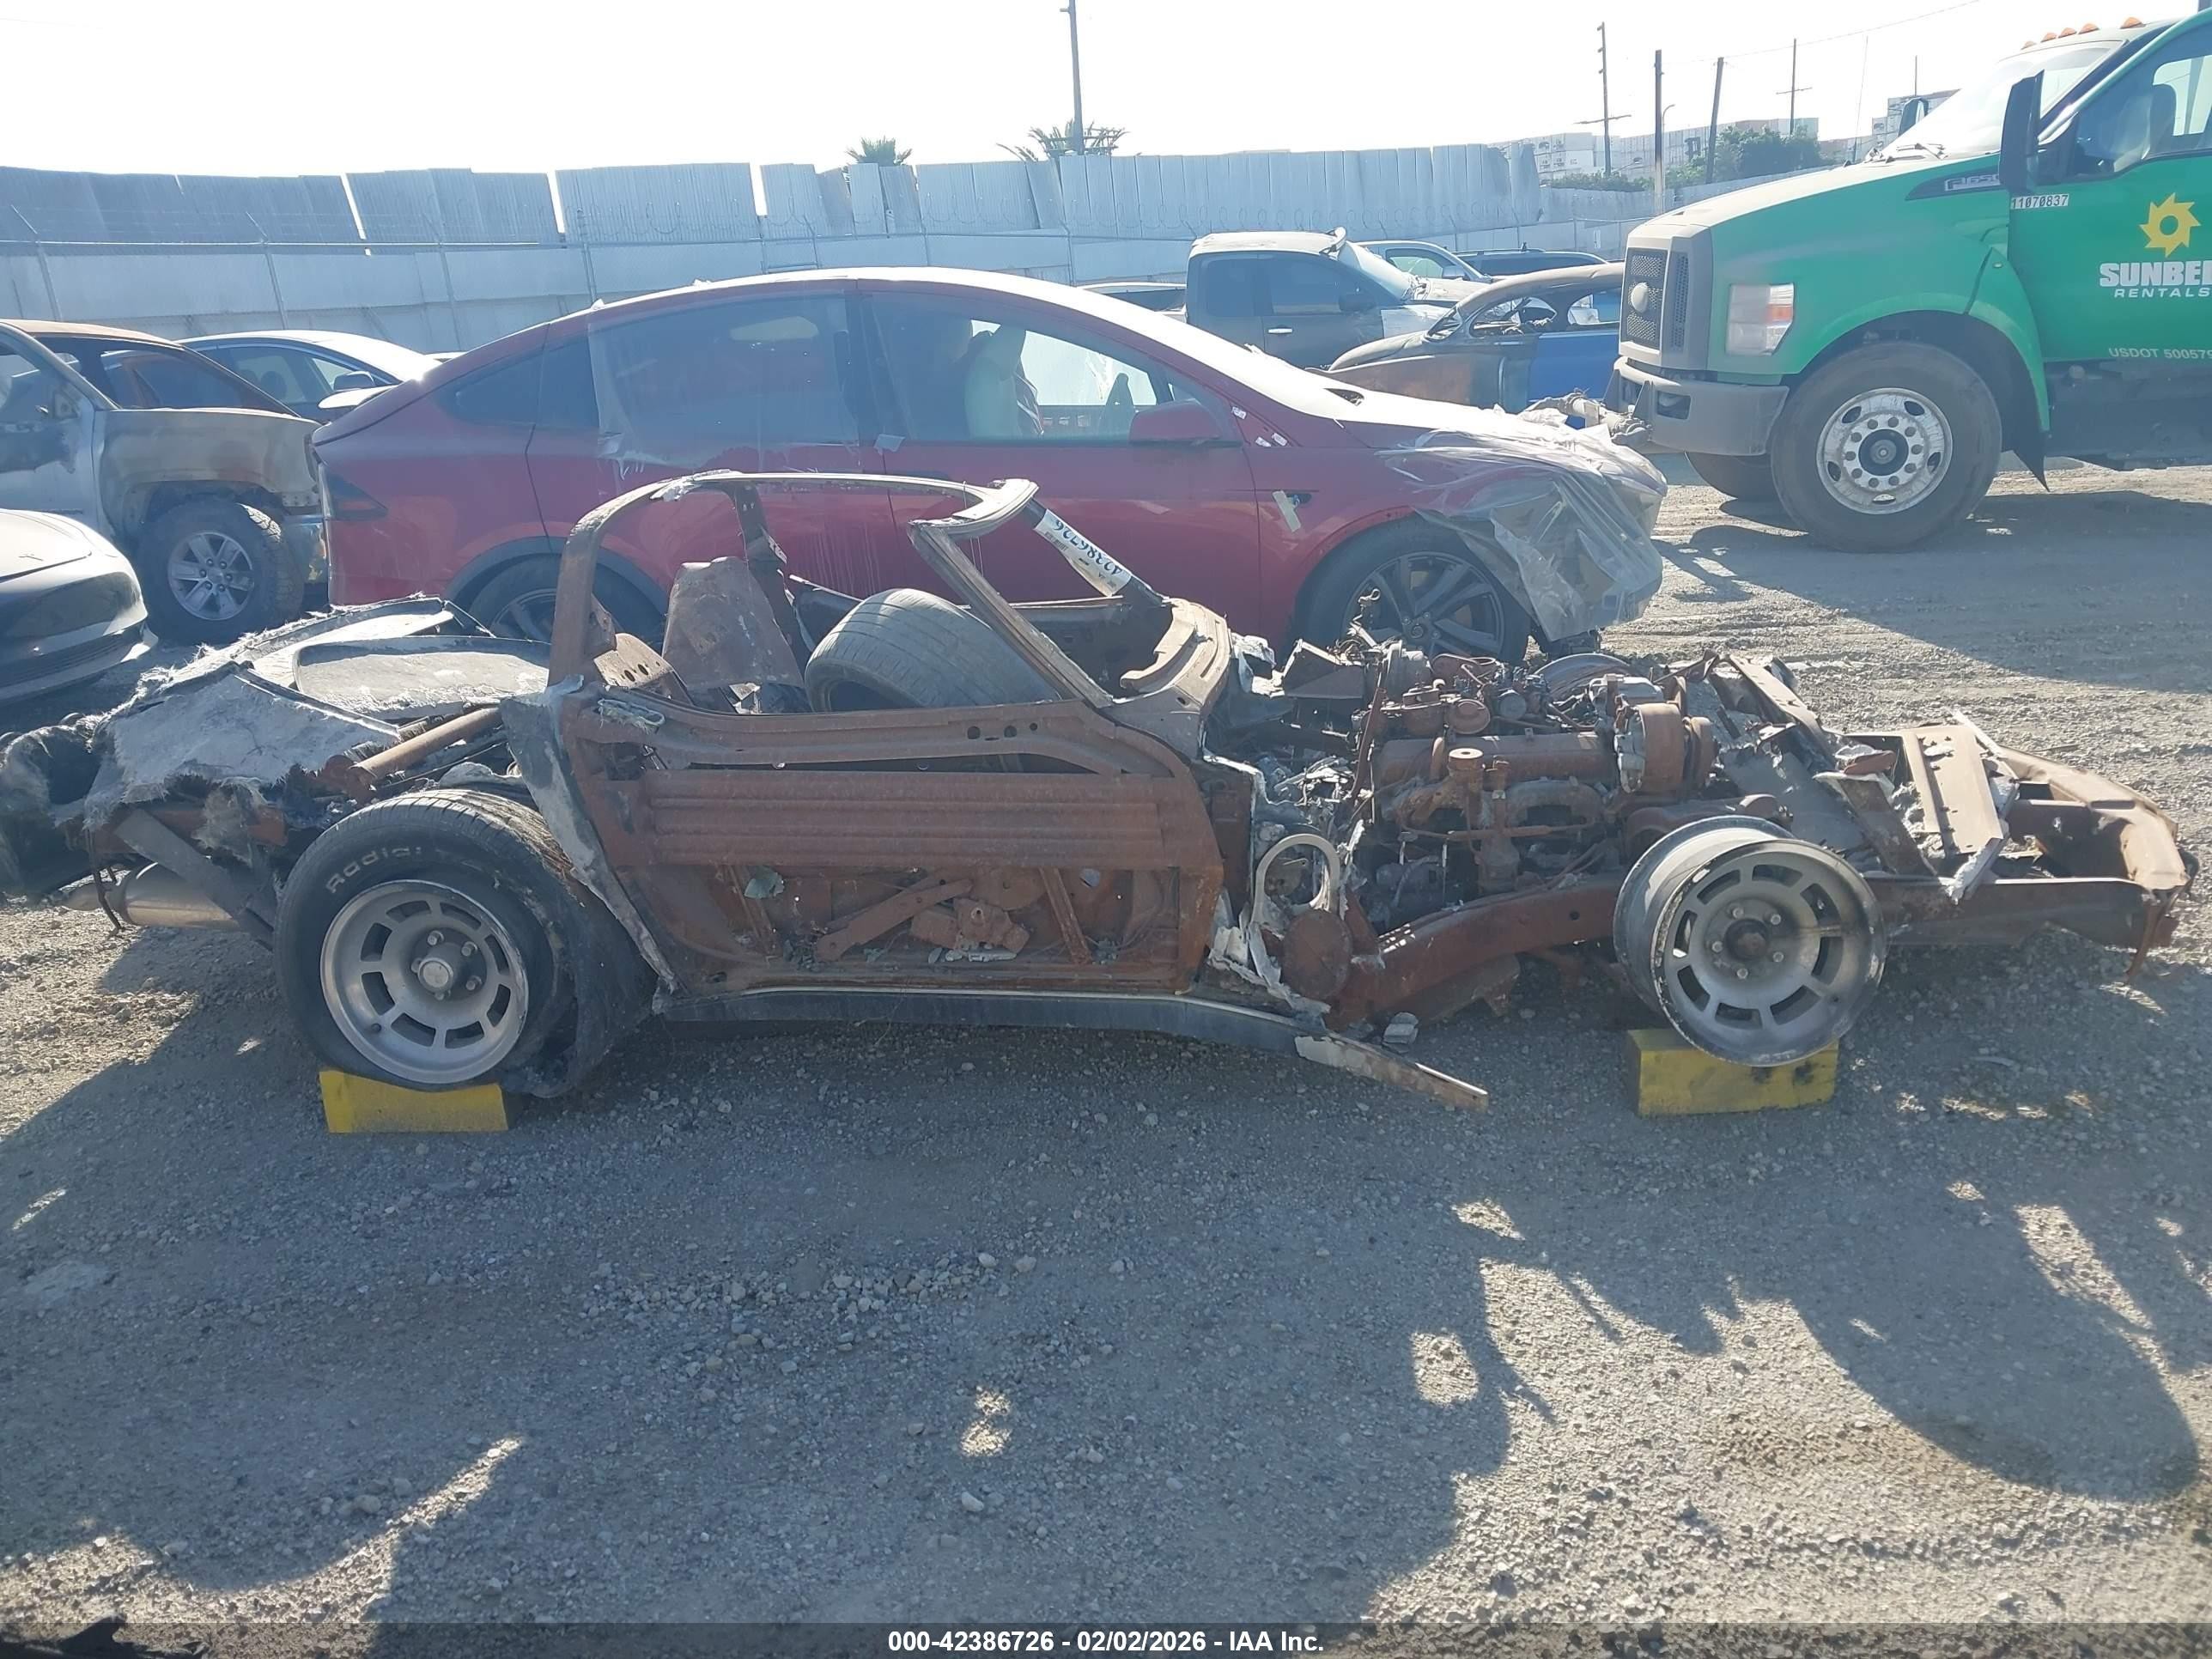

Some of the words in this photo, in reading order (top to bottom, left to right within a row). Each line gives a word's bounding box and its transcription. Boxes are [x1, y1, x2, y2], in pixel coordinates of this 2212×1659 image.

[2012, 195, 2069, 209] 11070837
[2114, 288, 2211, 298] RENTALS
[2108, 348, 2160, 358] USDOT
[1053, 519, 1122, 575] 42386726
